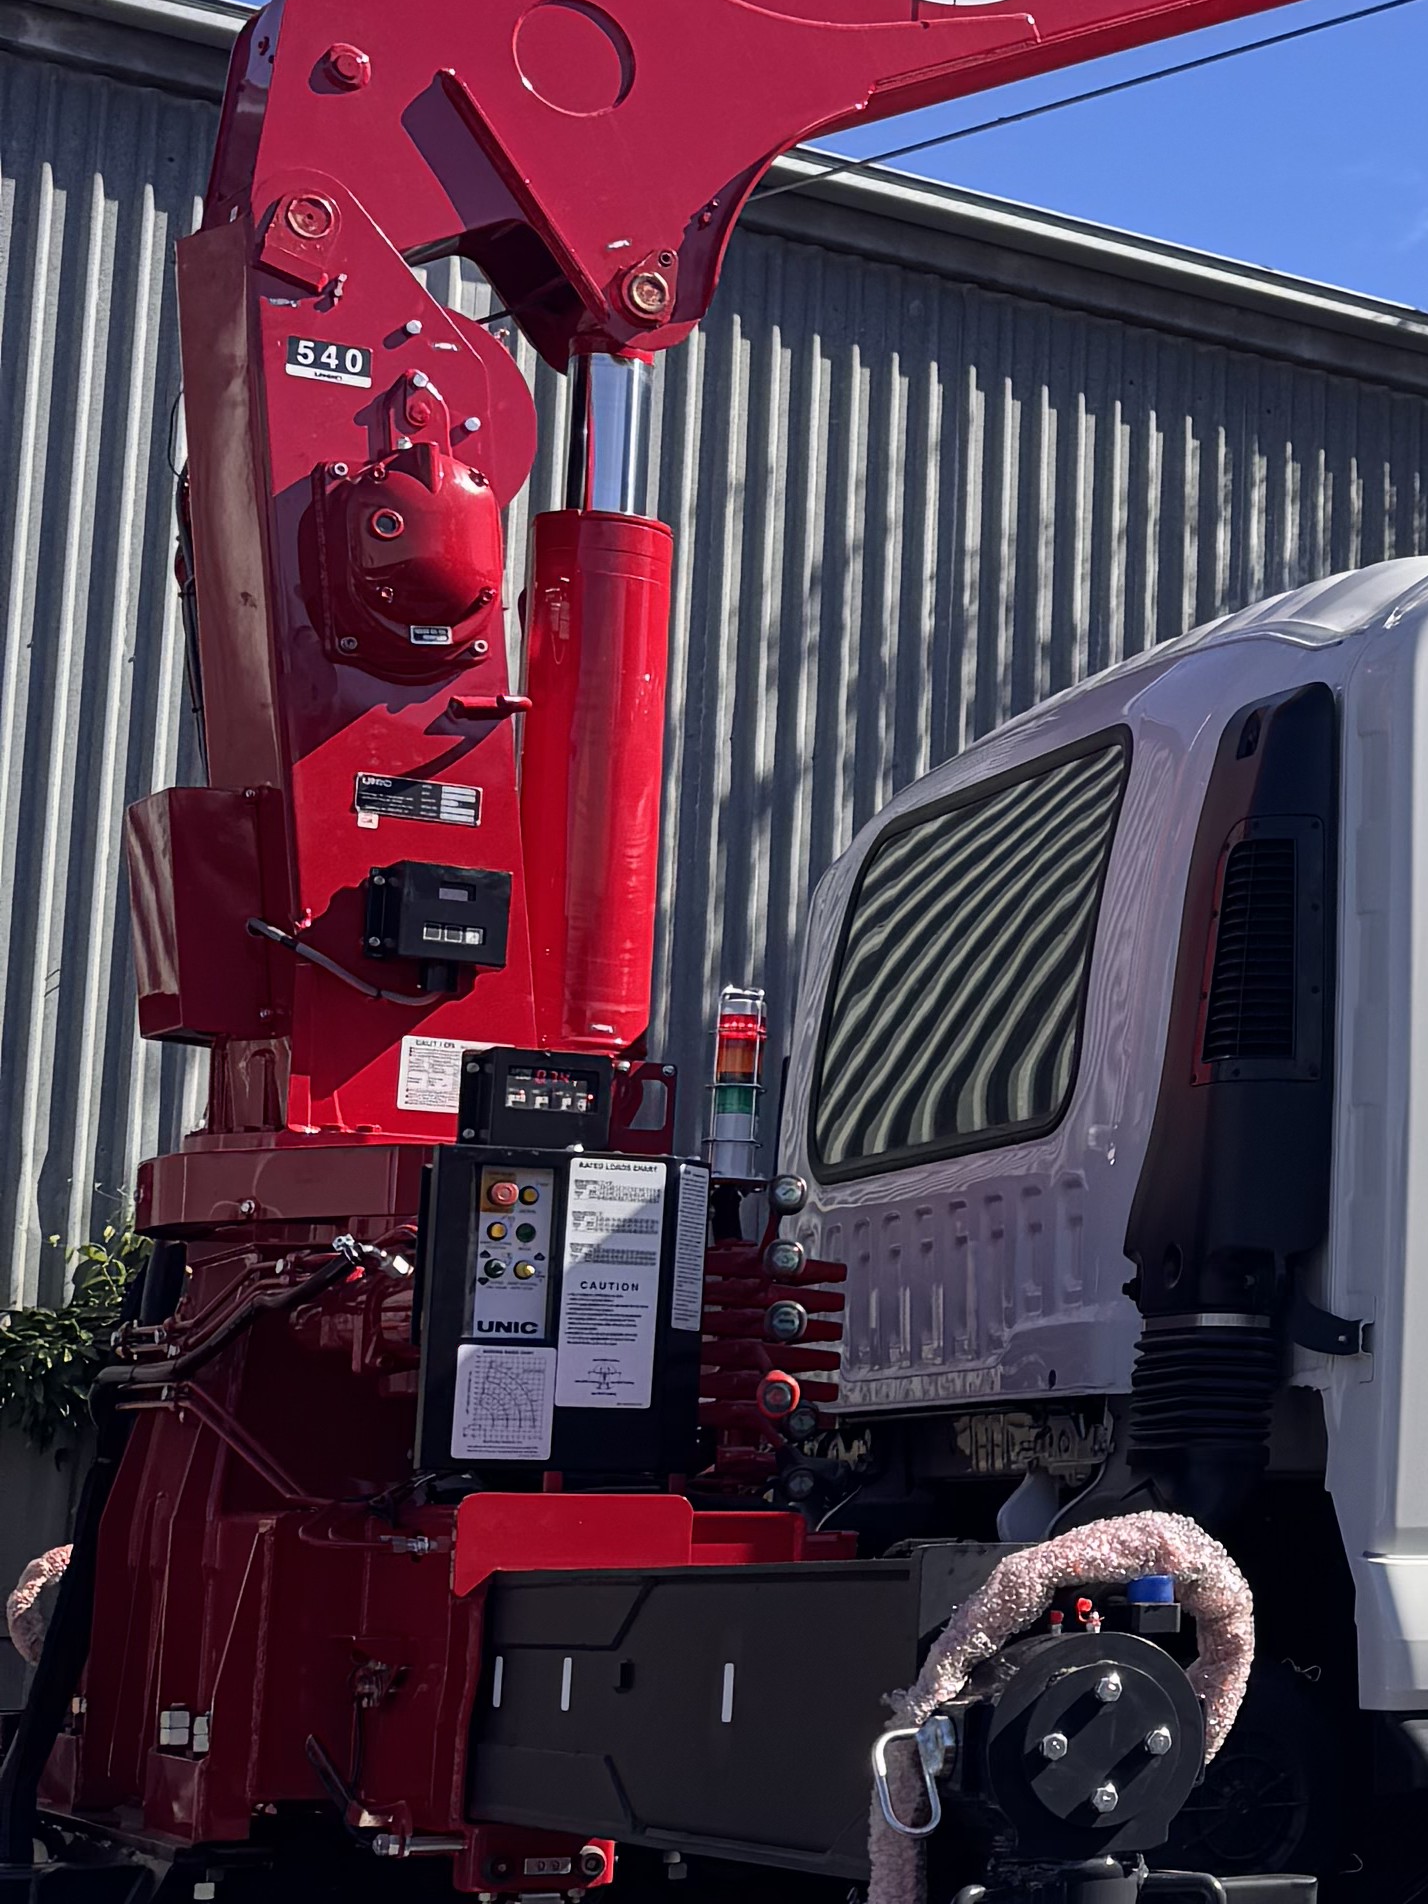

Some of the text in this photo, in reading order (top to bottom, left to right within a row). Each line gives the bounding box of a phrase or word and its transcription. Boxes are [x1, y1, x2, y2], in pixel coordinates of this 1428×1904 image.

[296, 339, 363, 373] 540
[580, 1280, 639, 1292] CAUTION
[477, 1320, 539, 1335] UNIC
